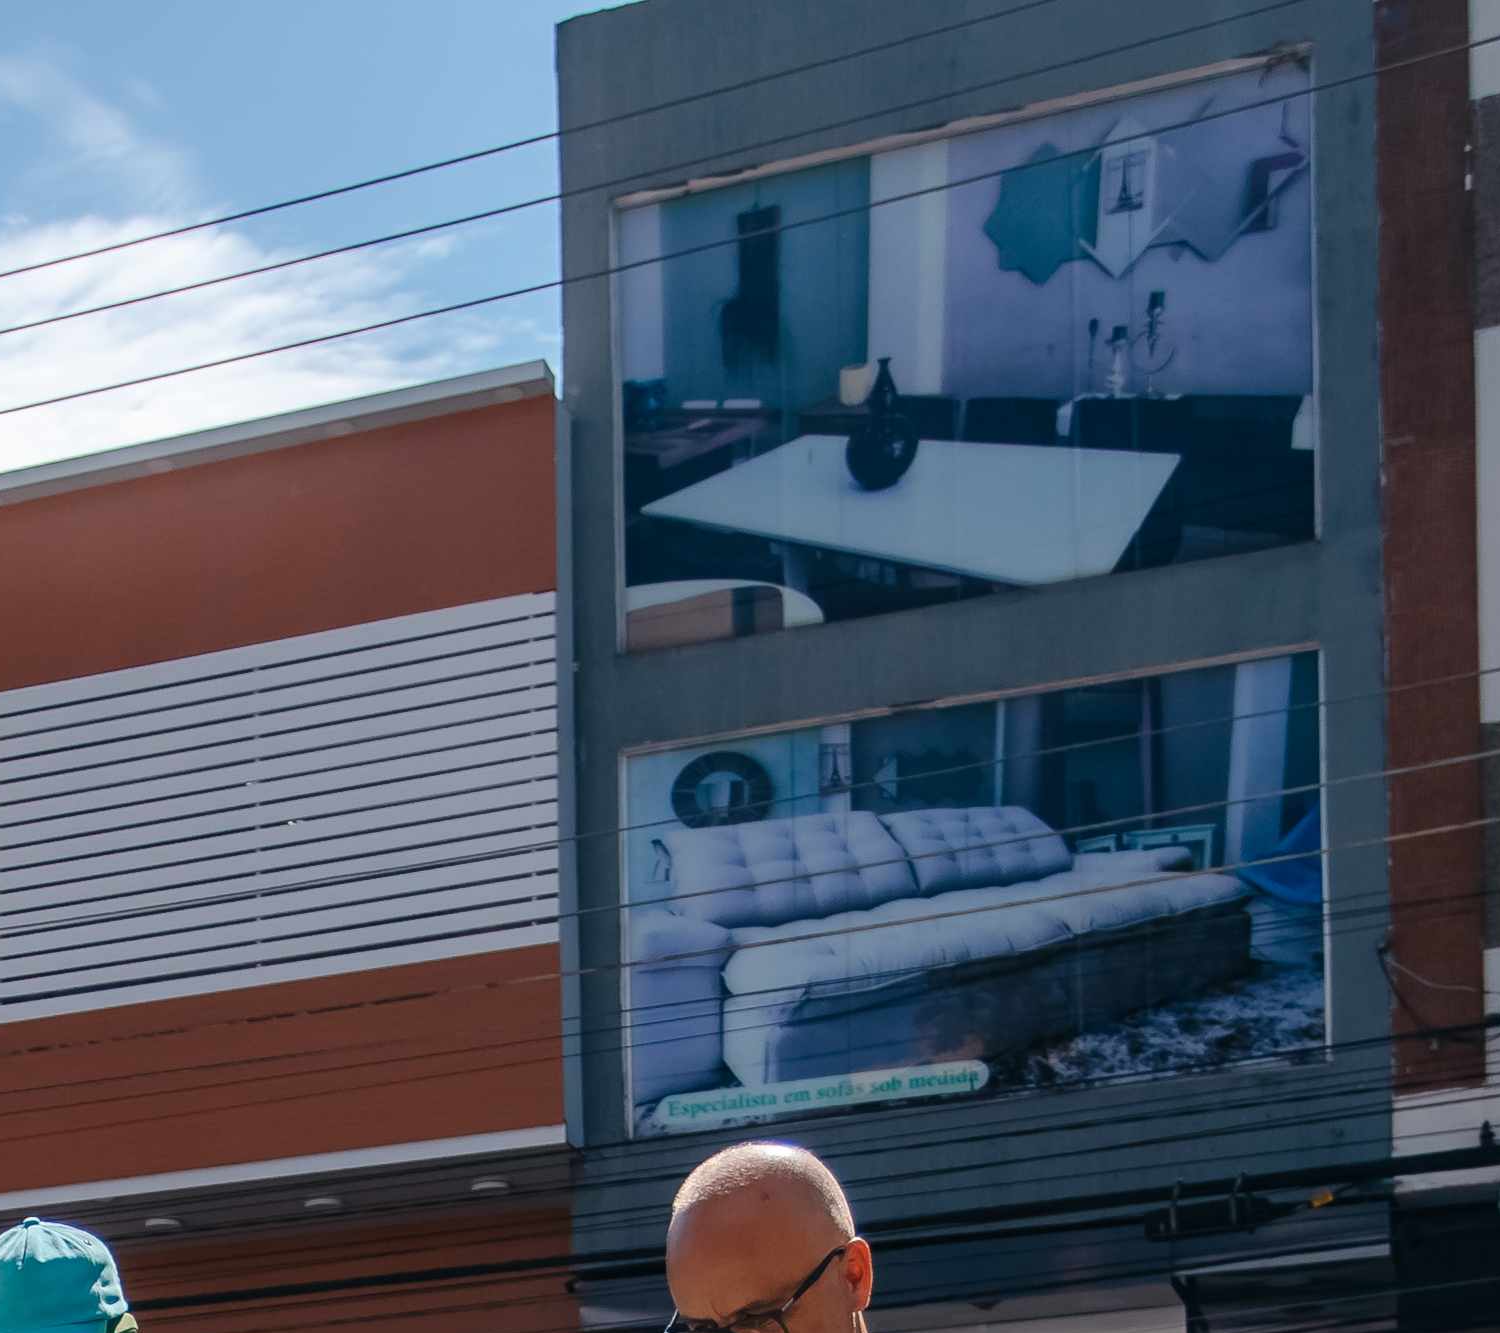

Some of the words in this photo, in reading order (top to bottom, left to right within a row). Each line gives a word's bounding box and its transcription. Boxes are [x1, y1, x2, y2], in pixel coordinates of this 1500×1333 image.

[667, 1092, 777, 1119] Especialista
[783, 1089, 812, 1104] em
[869, 1076, 903, 1095] sob
[907, 1067, 980, 1092] medida
